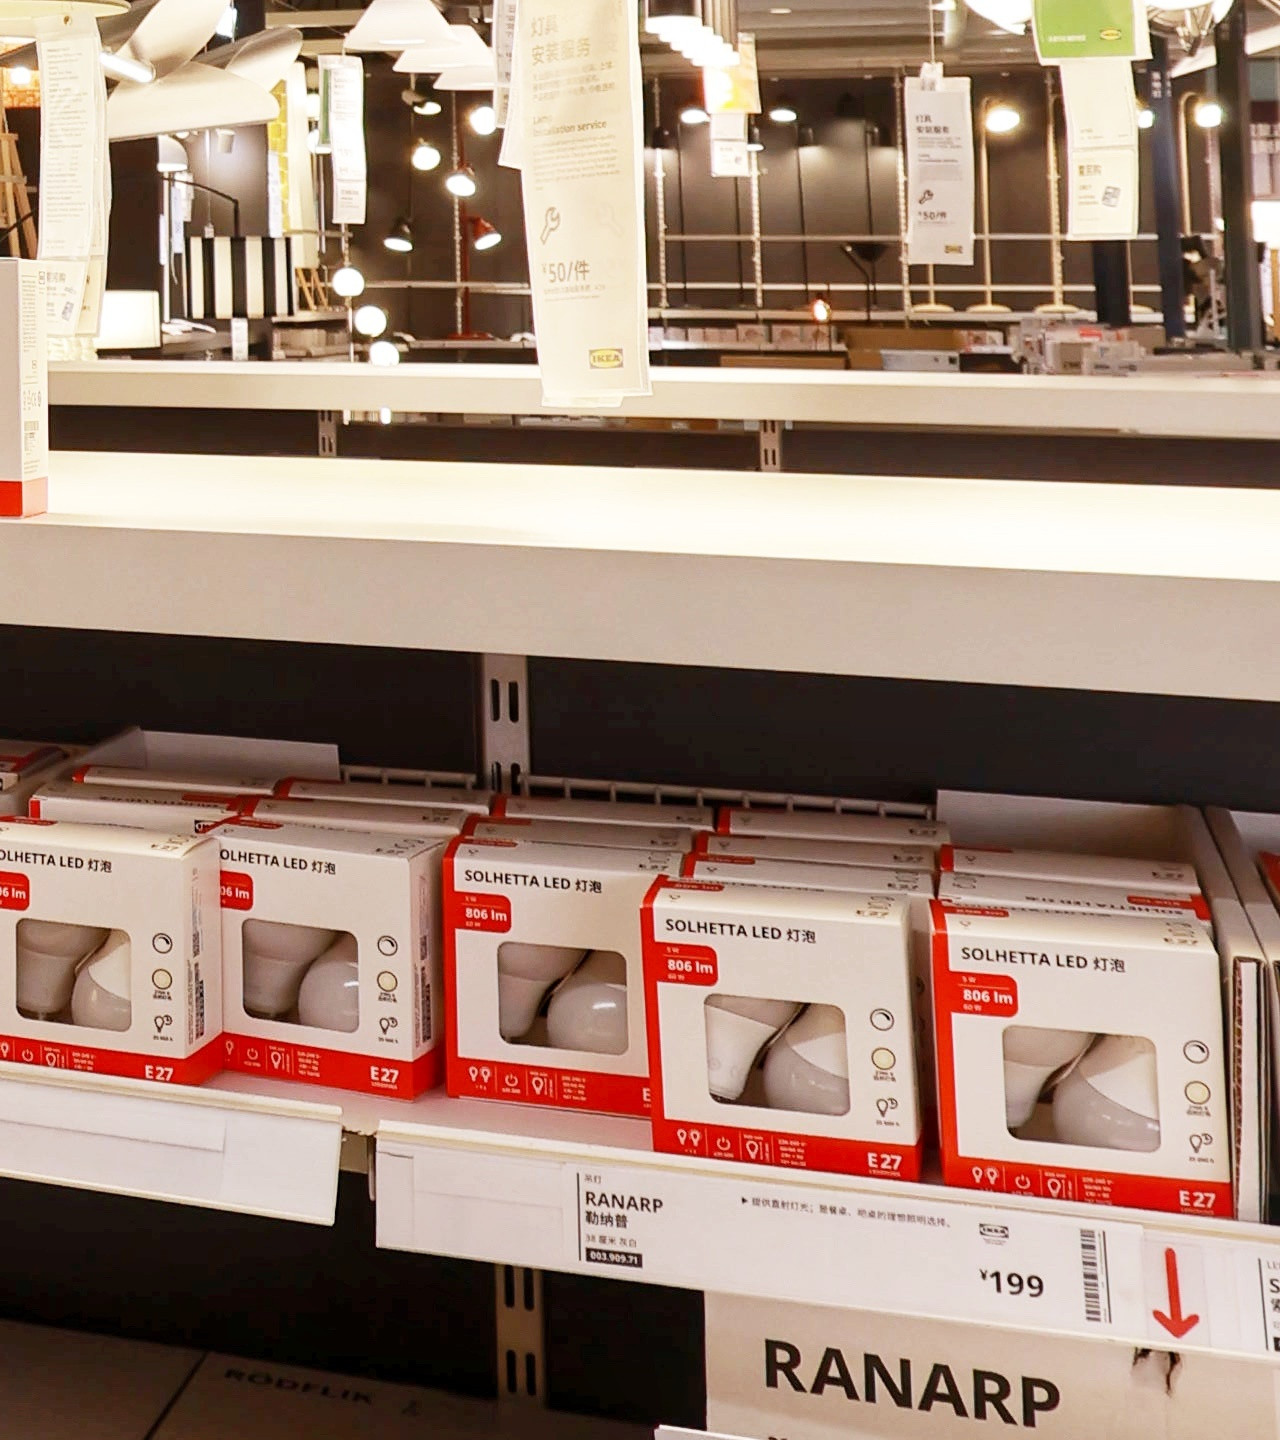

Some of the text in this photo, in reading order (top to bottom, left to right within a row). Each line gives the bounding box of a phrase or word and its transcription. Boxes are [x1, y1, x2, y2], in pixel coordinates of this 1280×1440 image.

[59, 854, 85, 870] LED
[87, 857, 113, 874] 灯泡
[219, 848, 337, 875] OLHETTA LED 灯泡
[464, 869, 603, 894] SOLHETTA LED 灯泡
[11, 887, 27, 900] lm
[235, 887, 250, 900] lm
[464, 907, 508, 922] 806 lm
[665, 917, 817, 944] SOLHETTA LED 灯泡
[667, 959, 714, 975] 806 lm
[960, 946, 1127, 975] SOLHETTA LED 灯泡
[962, 988, 1014, 1006] 806 lm
[584, 1191, 665, 1214] RANARP
[584, 1210, 629, 1229] 勒纳普
[589, 1250, 639, 1267] 003.909.71
[978, 1267, 1046, 1299] ¥199
[223, 1366, 375, 1408] RÖDFLIK
[763, 1337, 1062, 1429] RANARP
